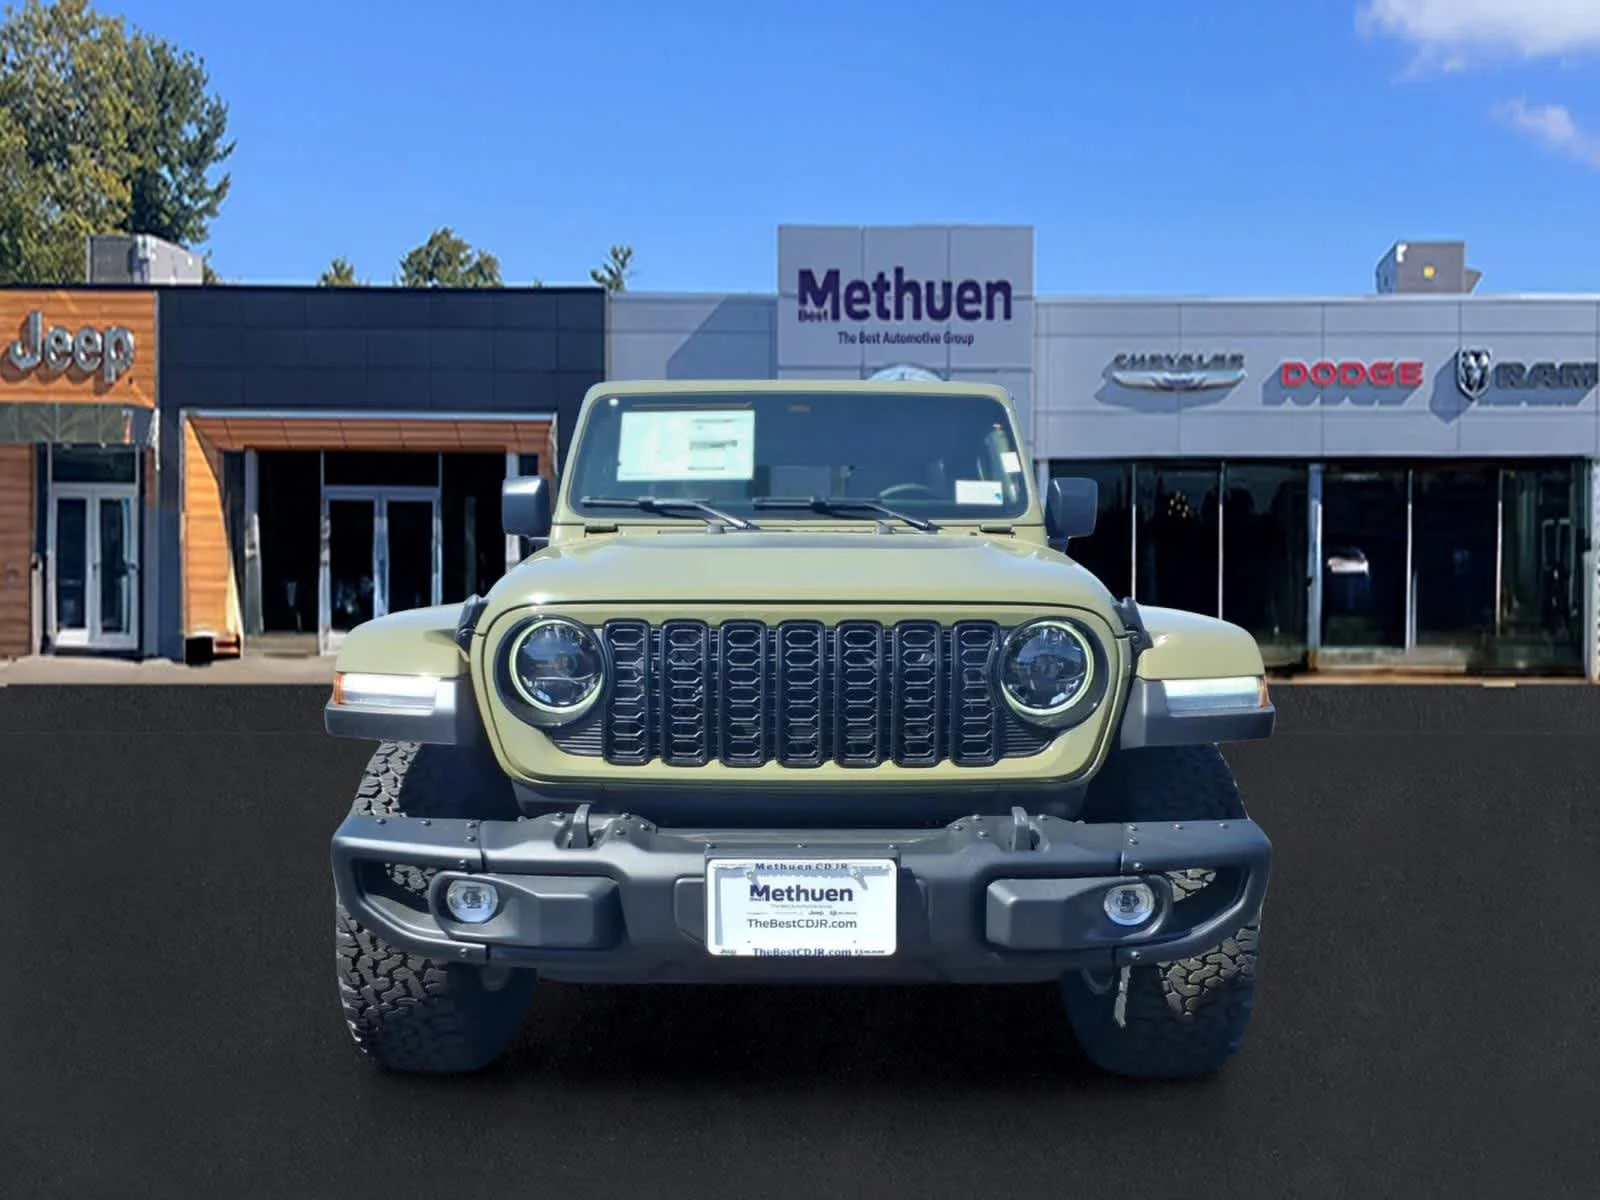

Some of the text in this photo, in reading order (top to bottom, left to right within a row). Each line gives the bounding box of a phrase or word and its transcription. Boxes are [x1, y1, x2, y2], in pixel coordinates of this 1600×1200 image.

[798, 266, 1012, 321] Methuen
[9, 310, 135, 384] Jeep
[838, 331, 974, 347] The Best Automotive Group
[1281, 361, 1424, 387] DODGE
[1495, 362, 1599, 389] RAM
[756, 863, 812, 871] Methuen
[815, 863, 849, 871] CDJR
[750, 884, 854, 902] Methuen
[747, 919, 858, 929] TheBestCDJR.com
[753, 947, 851, 957] TheBestCDJR.com
